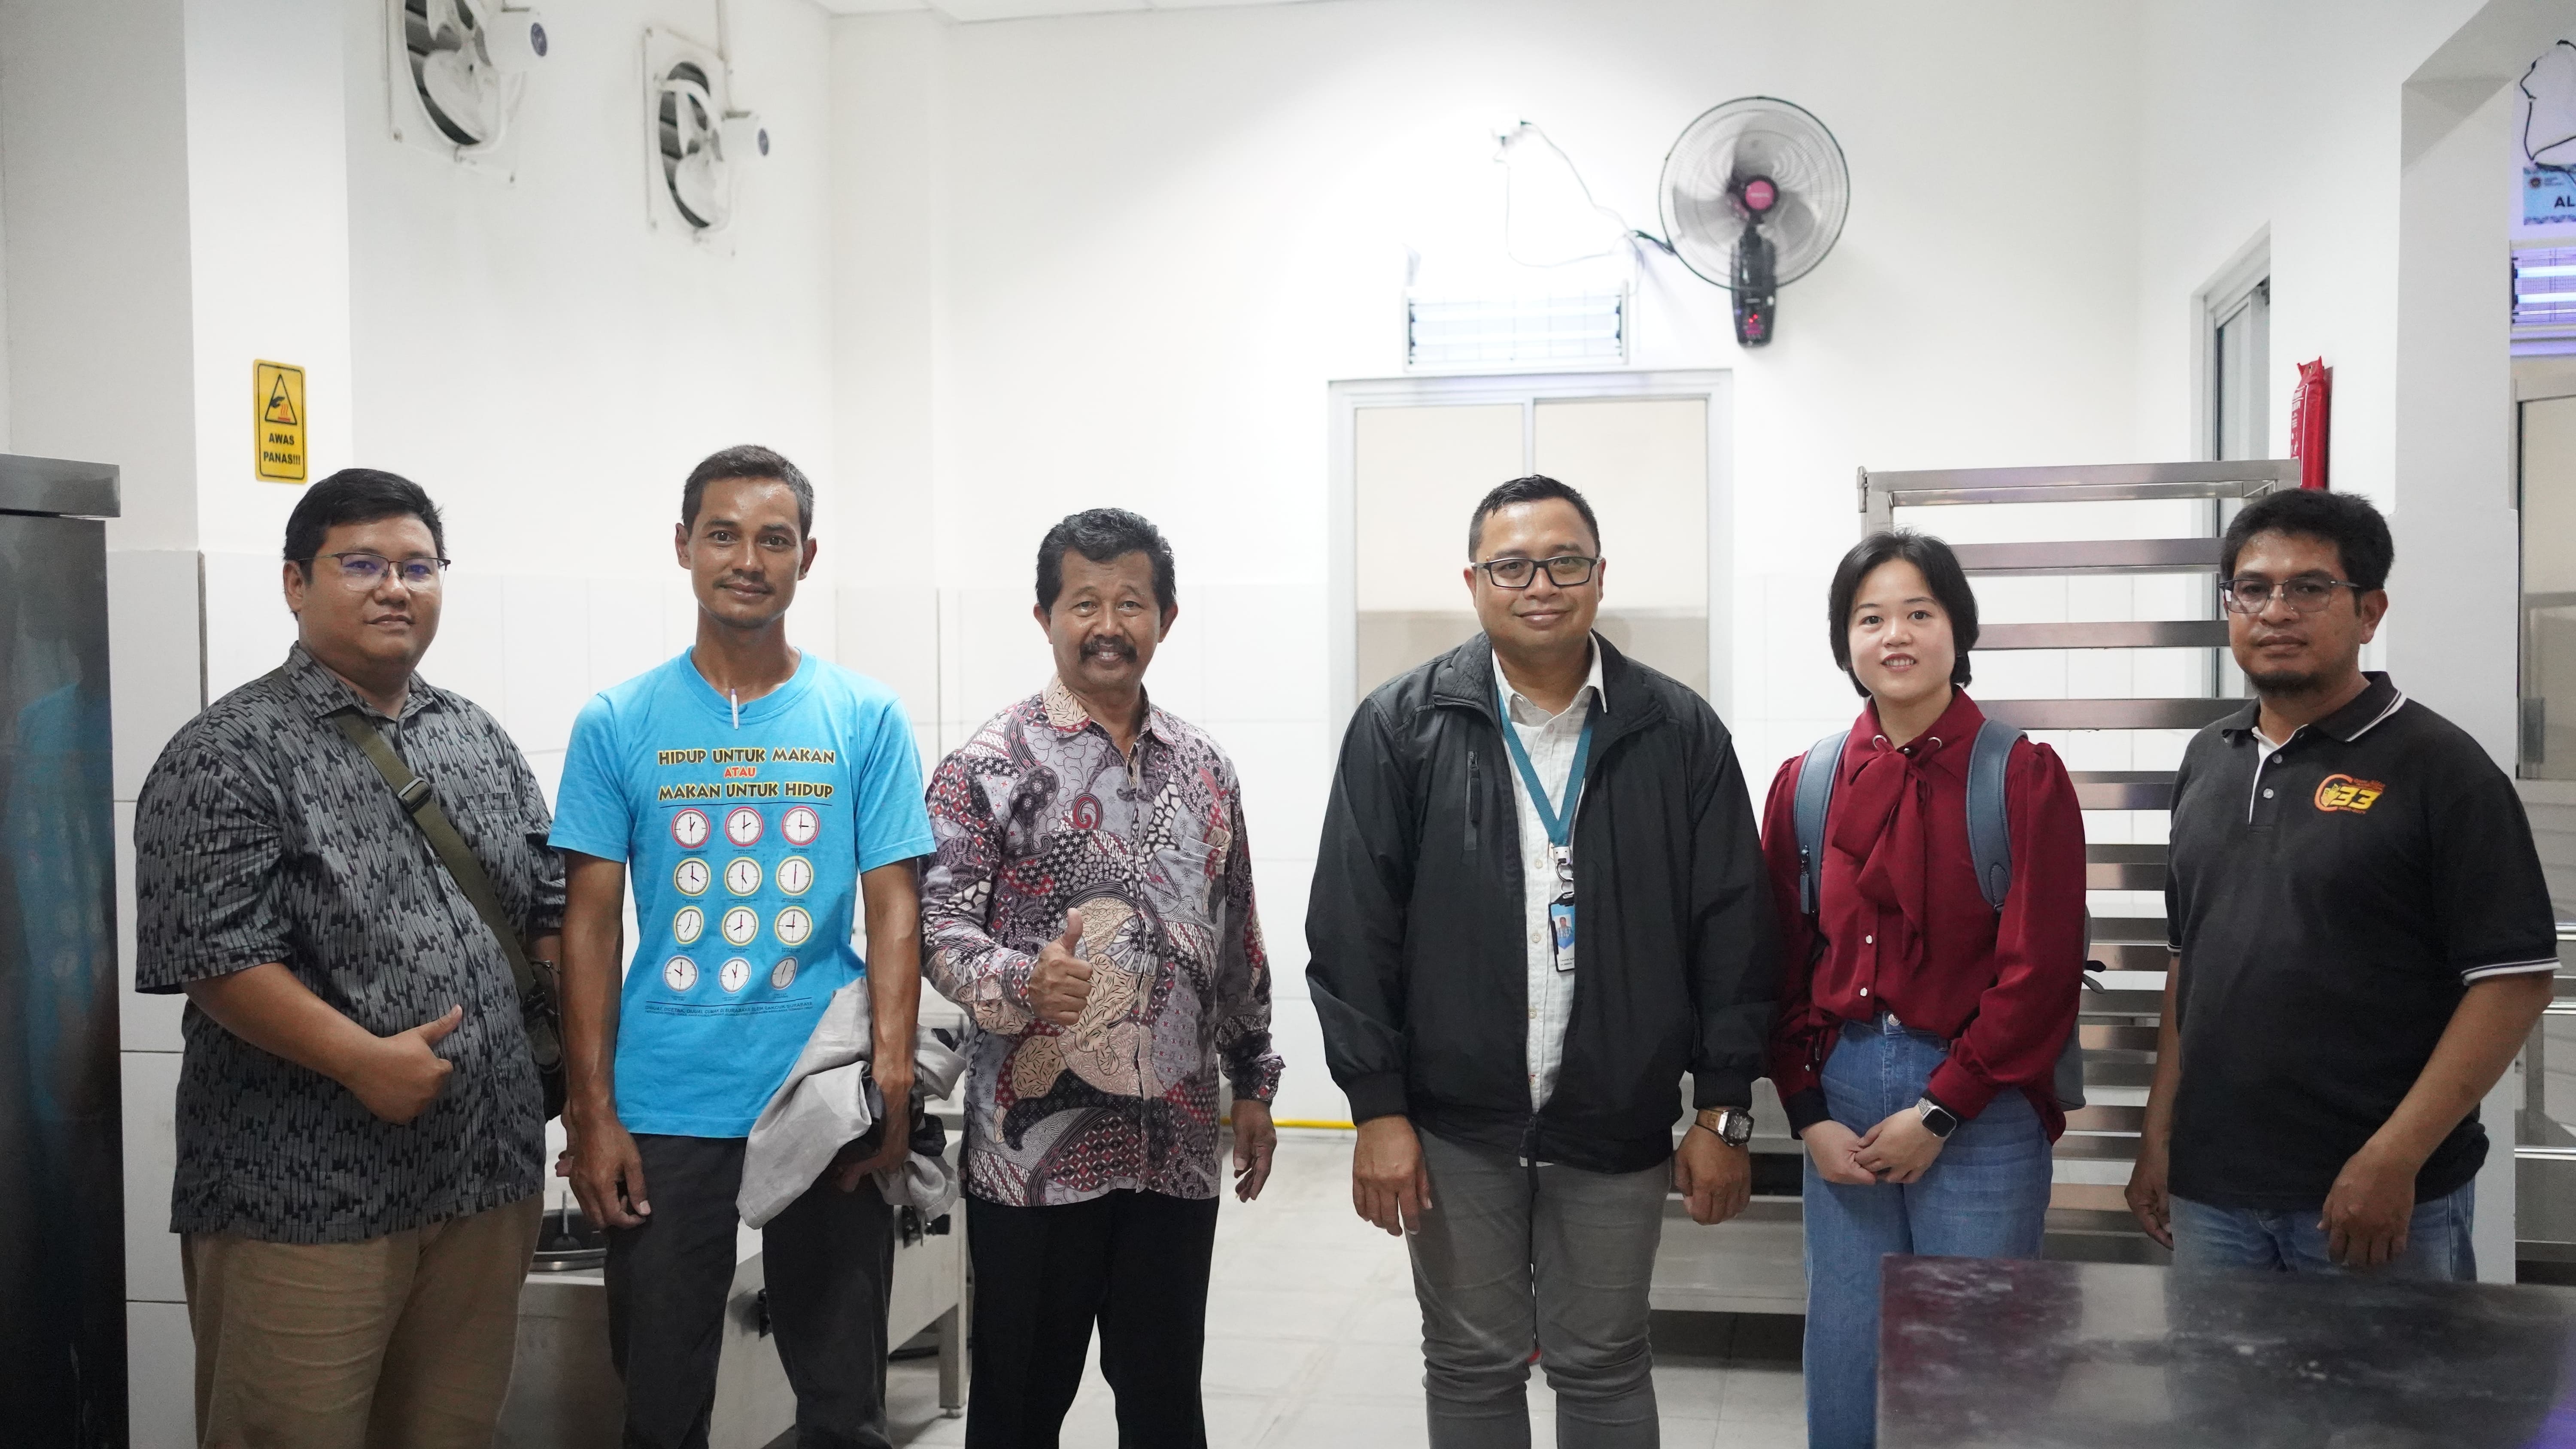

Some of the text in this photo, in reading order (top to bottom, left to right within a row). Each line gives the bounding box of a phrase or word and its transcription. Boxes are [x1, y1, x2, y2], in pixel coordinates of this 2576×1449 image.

[269, 433, 295, 445] AWAS
[263, 451, 301, 465] PANAS!!!
[658, 747, 835, 765] HIDUP UNTUK MAKAN
[724, 767, 756, 778] ATAU
[658, 782, 833, 801] MAKAN UNTUK HIDUP
